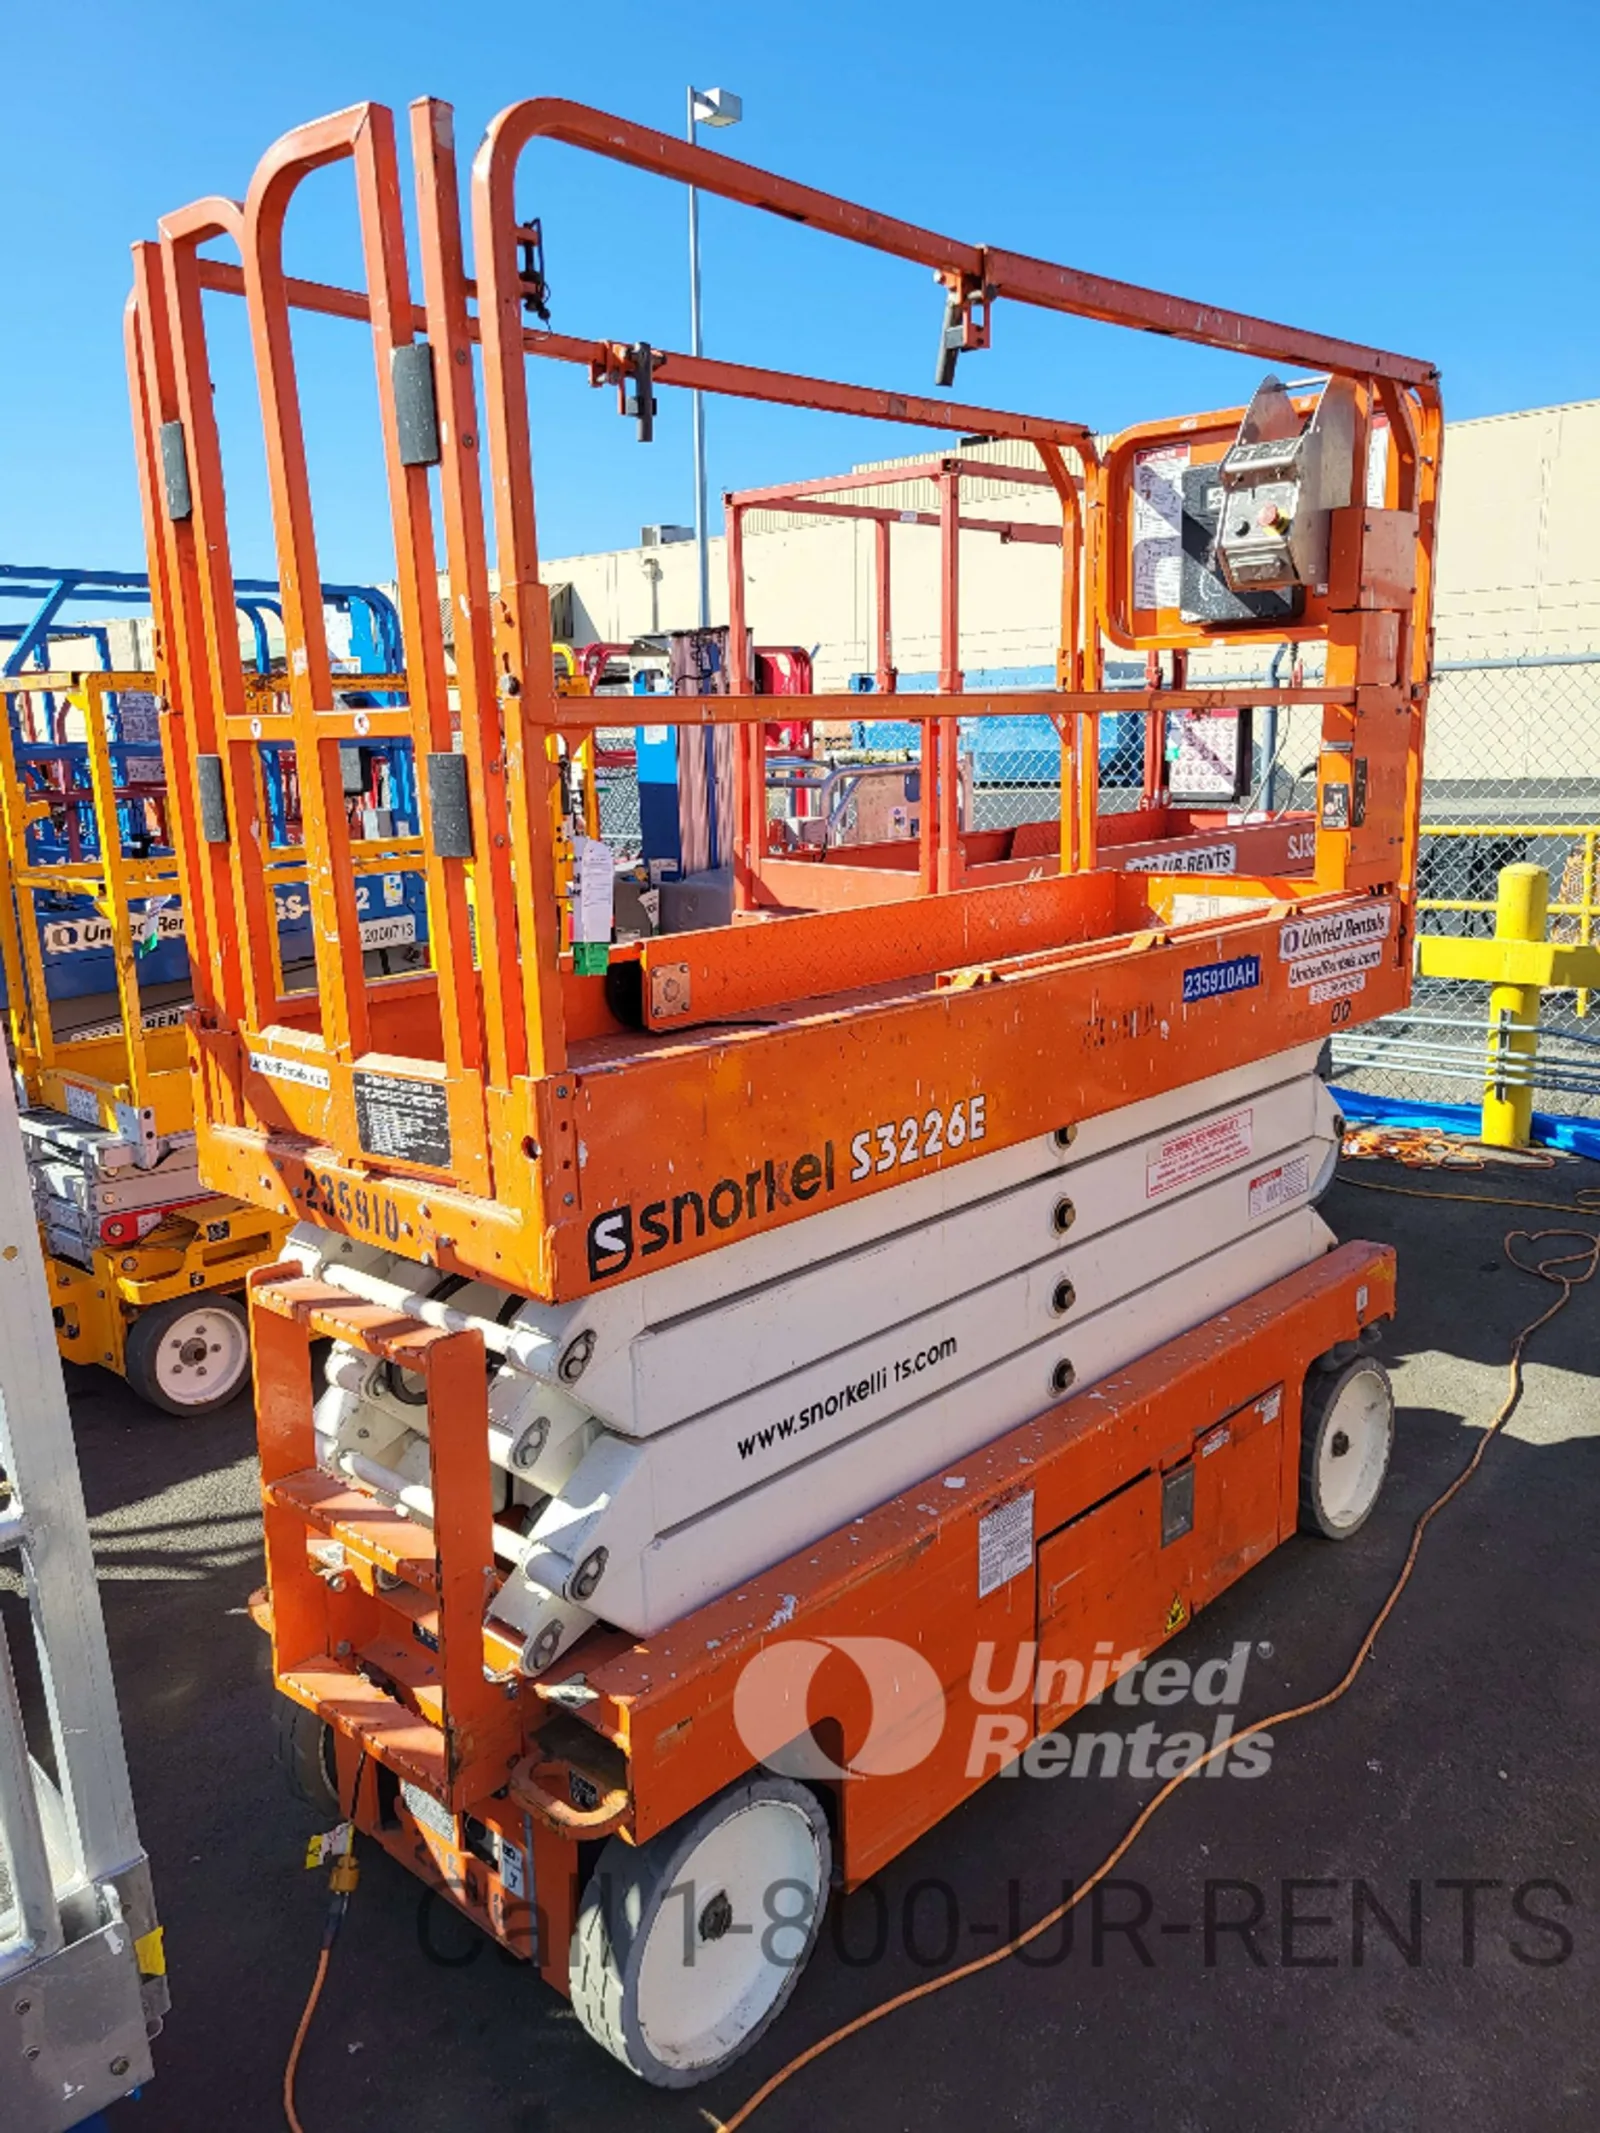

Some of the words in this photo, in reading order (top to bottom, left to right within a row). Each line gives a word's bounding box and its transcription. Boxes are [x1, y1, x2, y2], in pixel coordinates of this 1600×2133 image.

[1302, 919, 1343, 949] United
[1343, 912, 1385, 939] Rentals
[1184, 962, 1257, 997] 235910AH
[303, 1168, 399, 1243] 235910
[640, 1140, 835, 1257] snorkel
[849, 1094, 987, 1182] S3226E
[737, 1337, 958, 1460] www.snorkellits.com
